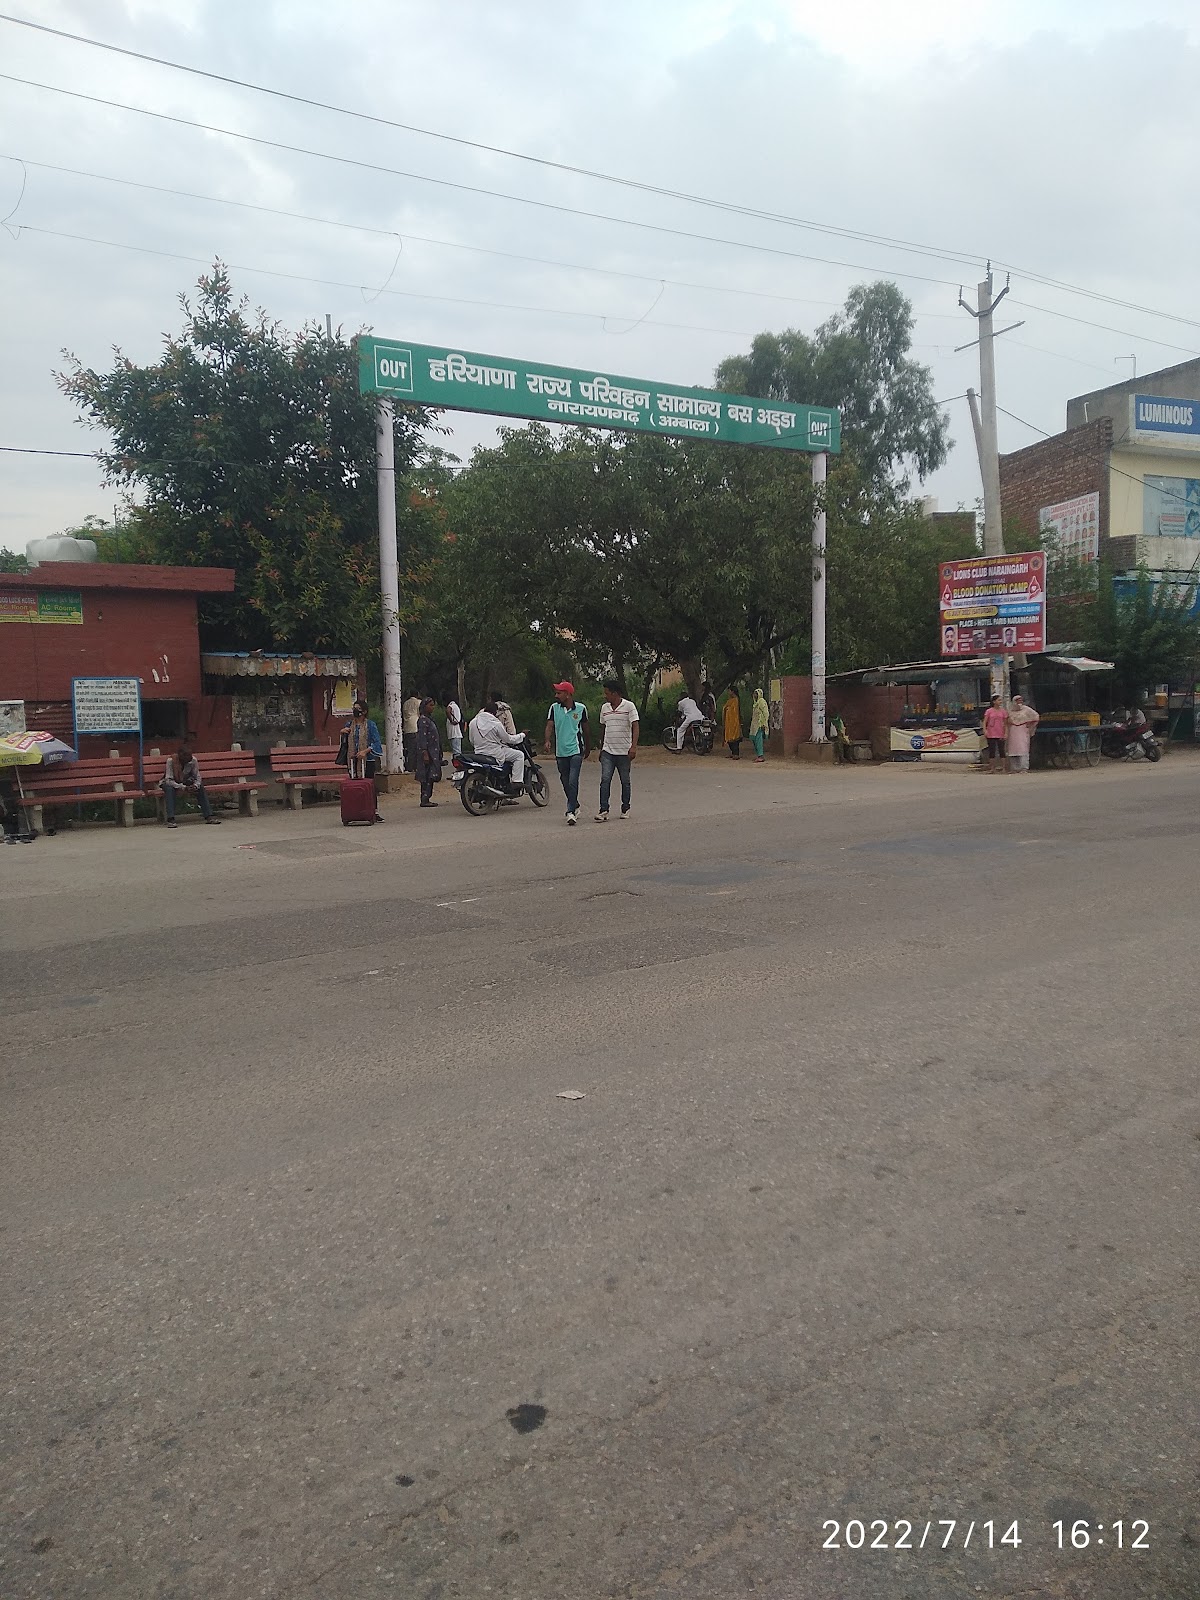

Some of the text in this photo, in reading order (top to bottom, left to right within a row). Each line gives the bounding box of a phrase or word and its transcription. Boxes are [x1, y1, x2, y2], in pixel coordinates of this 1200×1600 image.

[380, 359, 407, 379] OUT
[428, 354, 517, 390] हरियाणा
[526, 373, 572, 397] राज्य
[579, 377, 650, 409] परिवहन
[657, 393, 722, 419] सामान्य
[727, 404, 753, 423] बस
[547, 399, 640, 425] नारायणगढ़
[1140, 402, 1193, 426] LUMINOUS
[811, 421, 828, 437] OUT
[953, 563, 1029, 580] LIONS CLUB NARAINGARH
[953, 582, 1029, 598] BLOOD DONATION CAMP
[959, 619, 973, 627] PLACE
[978, 618, 992, 626] HOTEL
[1, 755, 27, 763] MOBILE
